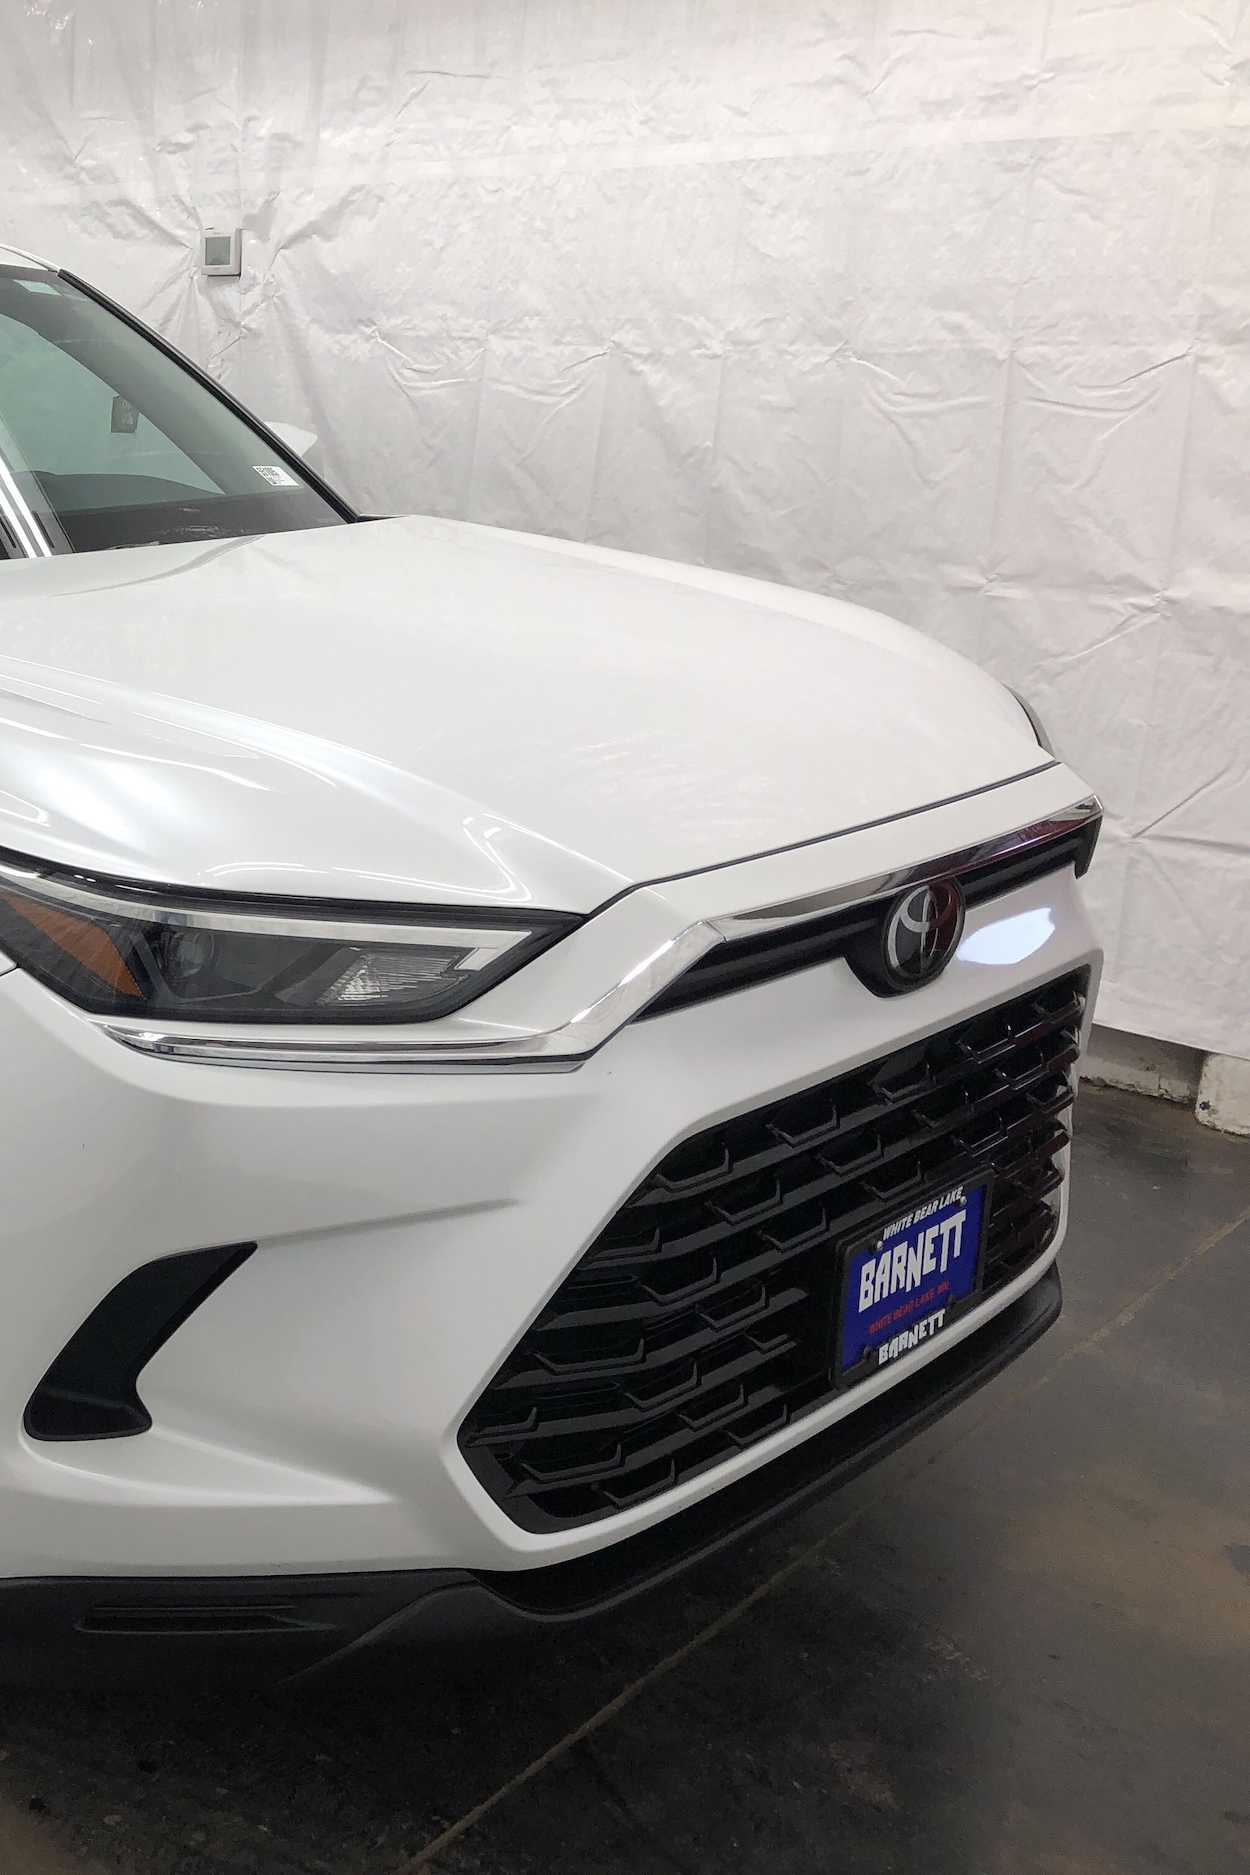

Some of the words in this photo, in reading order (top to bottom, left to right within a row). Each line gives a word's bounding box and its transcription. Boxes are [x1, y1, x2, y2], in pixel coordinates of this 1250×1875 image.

[883, 1213, 914, 1241] WHITE
[913, 1200, 939, 1224] BEAR
[938, 1186, 963, 1210] LAKE
[859, 1210, 966, 1313] BARNETT
[869, 1312, 893, 1334] WHITE
[893, 1300, 915, 1320] BEAR
[878, 1309, 945, 1365] BARNETT
